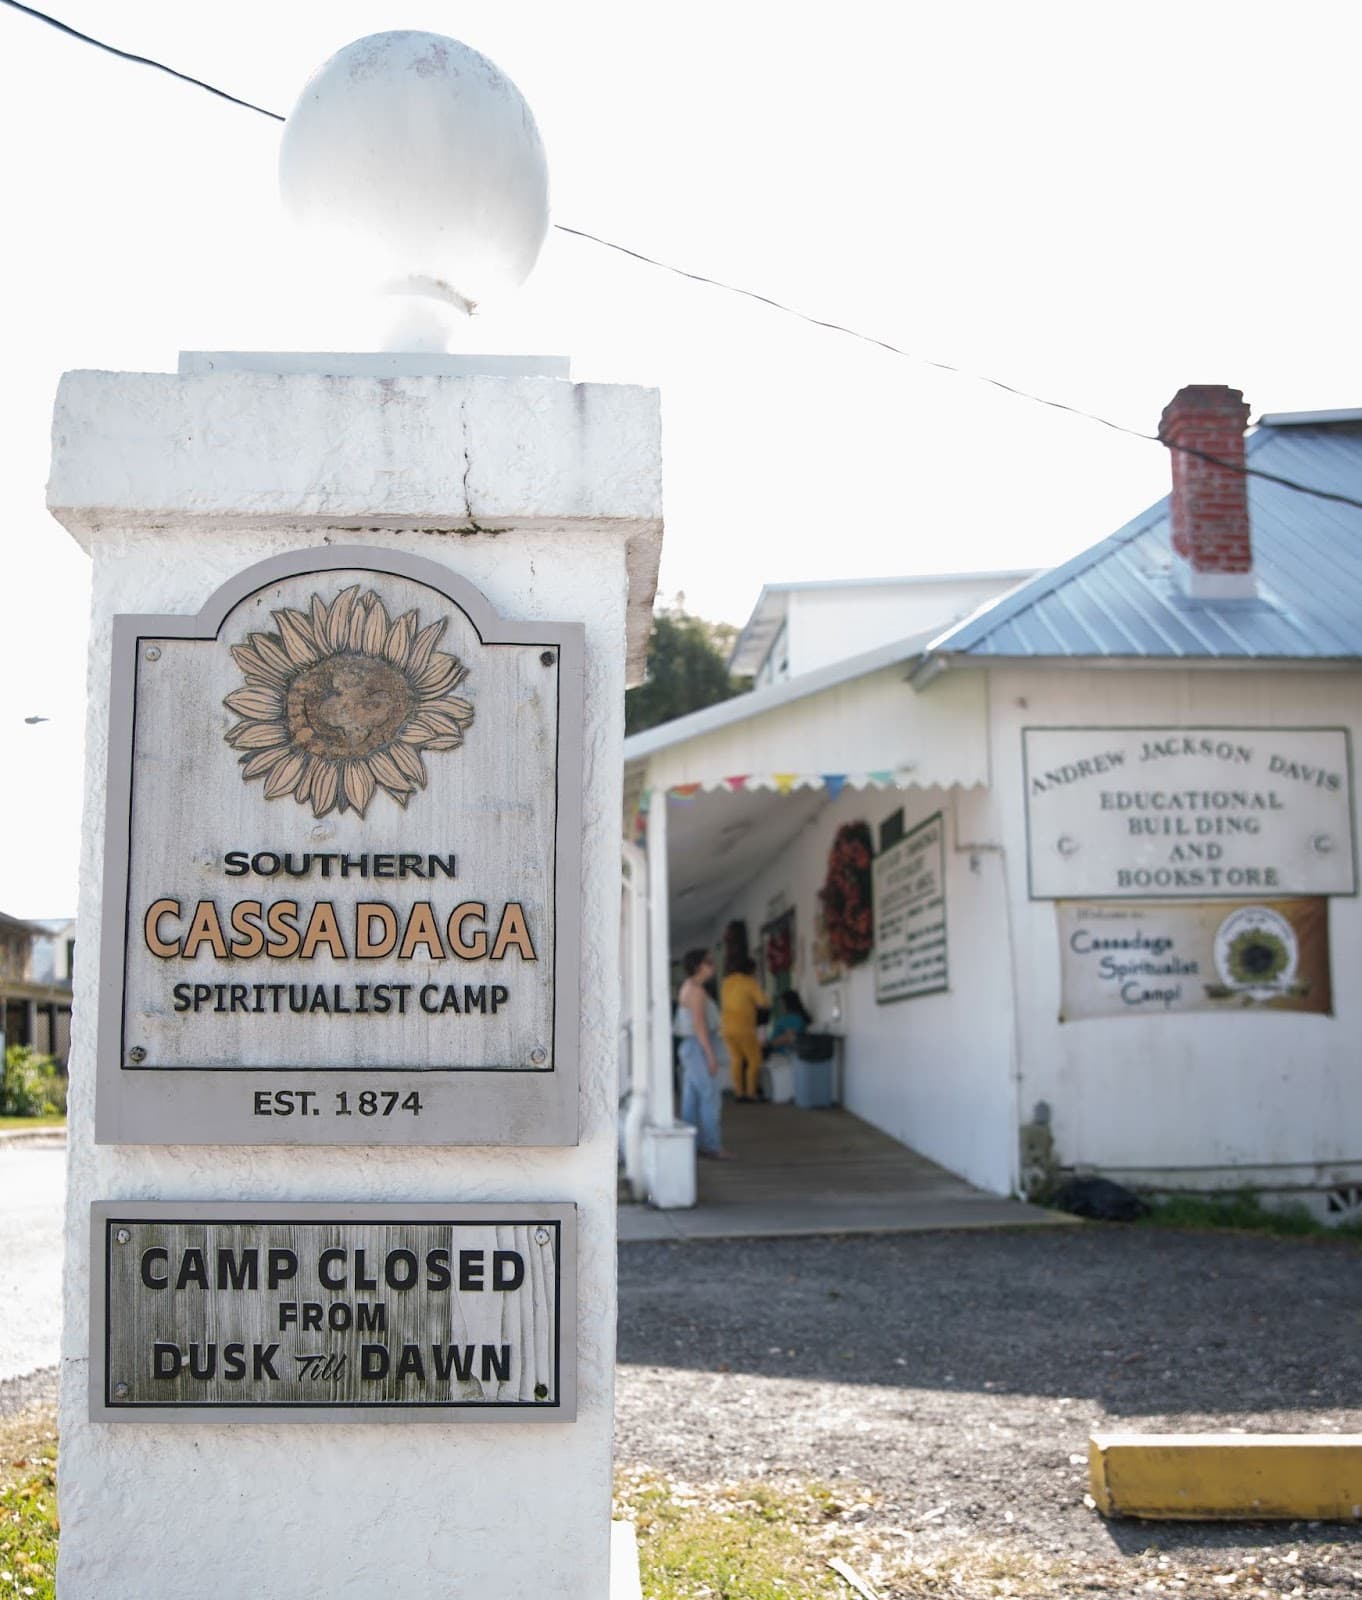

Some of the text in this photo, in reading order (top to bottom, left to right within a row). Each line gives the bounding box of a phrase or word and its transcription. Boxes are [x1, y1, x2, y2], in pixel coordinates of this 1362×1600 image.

[1031, 737, 1342, 795] ANDREW JACKSON DAVIS
[1100, 791, 1283, 812] EDUCATIONAL
[1128, 816, 1261, 835] BUILDING
[224, 851, 456, 878] SOUTHERN
[1169, 842, 1223, 862] AND
[1117, 867, 1279, 888] BOOKSTORE
[144, 898, 537, 960] CASSADAGA
[173, 983, 509, 1014] SPIRITUALIST CAMP
[253, 1091, 424, 1116] EST. 1874
[141, 1246, 525, 1291] CAMP CLOSED
[279, 1302, 386, 1332] FROM
[154, 1342, 511, 1382] DUSK Till DAWN
